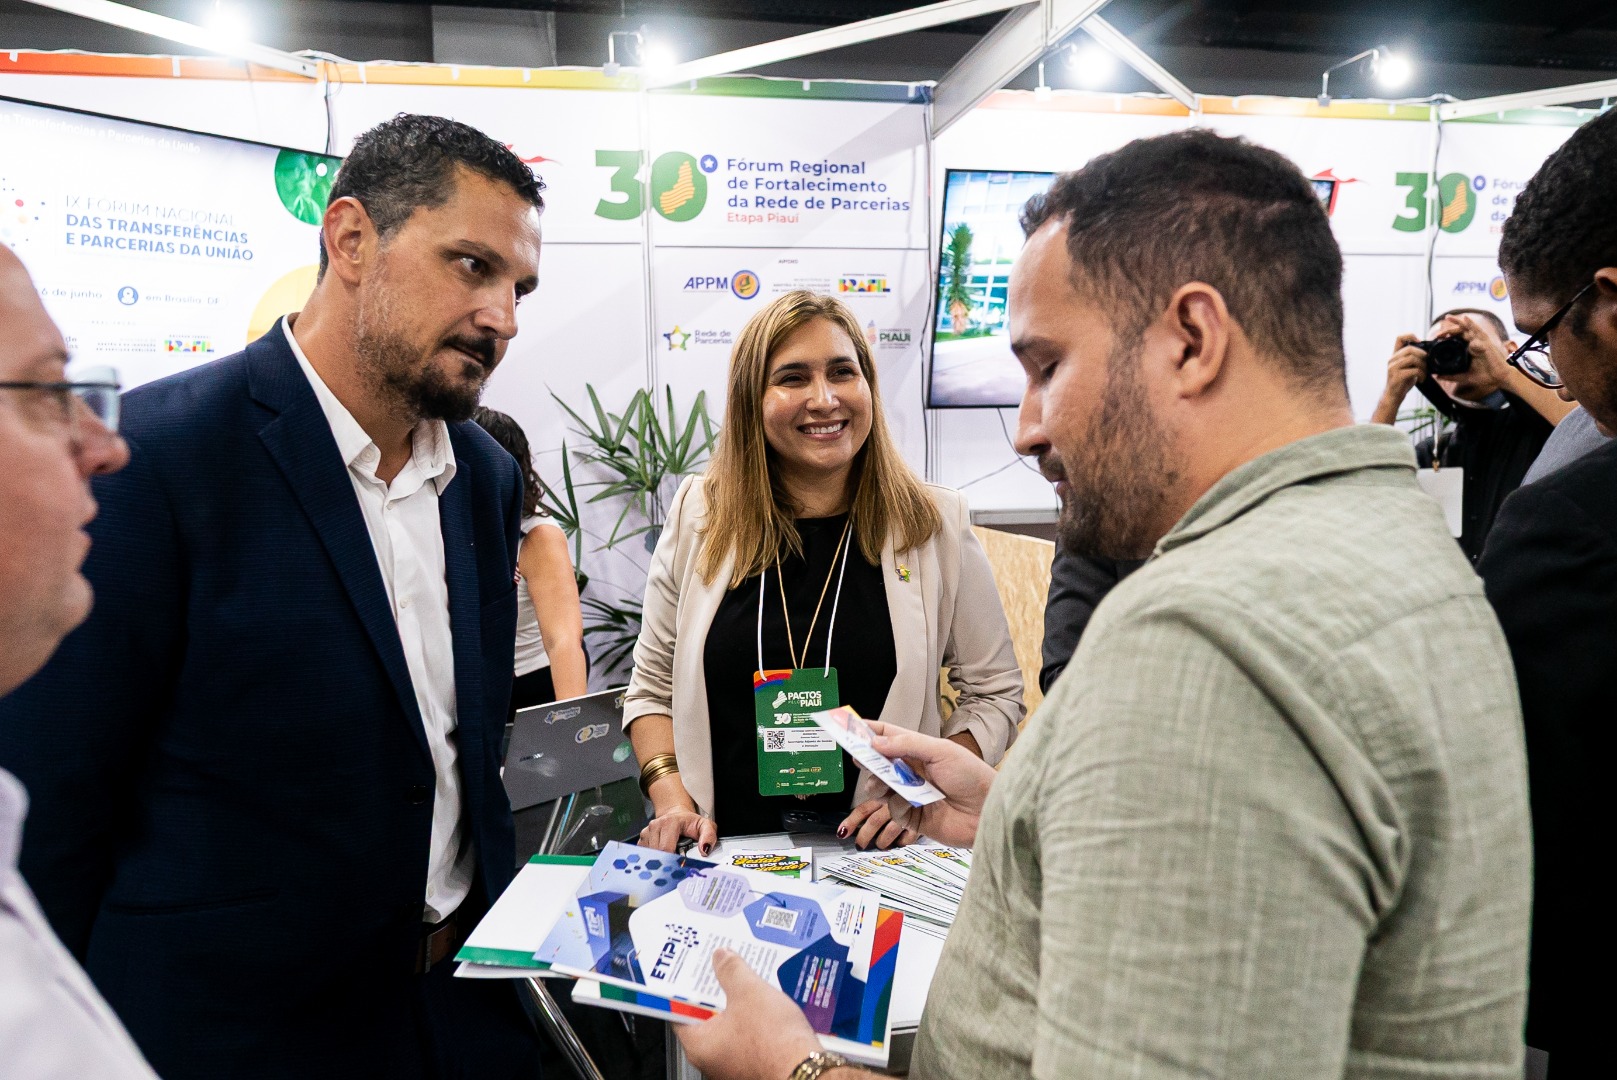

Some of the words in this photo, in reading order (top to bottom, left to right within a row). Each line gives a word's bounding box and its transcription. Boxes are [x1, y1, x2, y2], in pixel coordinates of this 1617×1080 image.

[727, 158, 784, 172] Fórum
[790, 160, 865, 177] Regional
[728, 177, 748, 190] de
[755, 178, 887, 193] Fortalecimento
[728, 196, 749, 208] da
[756, 197, 799, 209] Rede
[804, 198, 825, 210] de
[831, 197, 910, 212] Parcerias
[1492, 195, 1507, 205] de
[66, 195, 80, 208] IX
[156, 206, 234, 226] NACIONAL
[1491, 211, 1506, 221] da
[727, 212, 764, 224] Etapa
[767, 212, 799, 224] Piauí
[66, 214, 102, 229] DAS
[107, 218, 248, 244] TRANSFERÊNCIAS
[66, 232, 75, 245] E
[81, 234, 175, 254] PARCERIAS
[180, 244, 201, 256] DA
[205, 245, 253, 261] UNIÃO
[683, 276, 728, 290] APPM
[838, 278, 891, 292] BRASIL
[1453, 281, 1487, 292] APPM
[70, 289, 102, 300] junho
[788, 691, 822, 700] PACTOS
